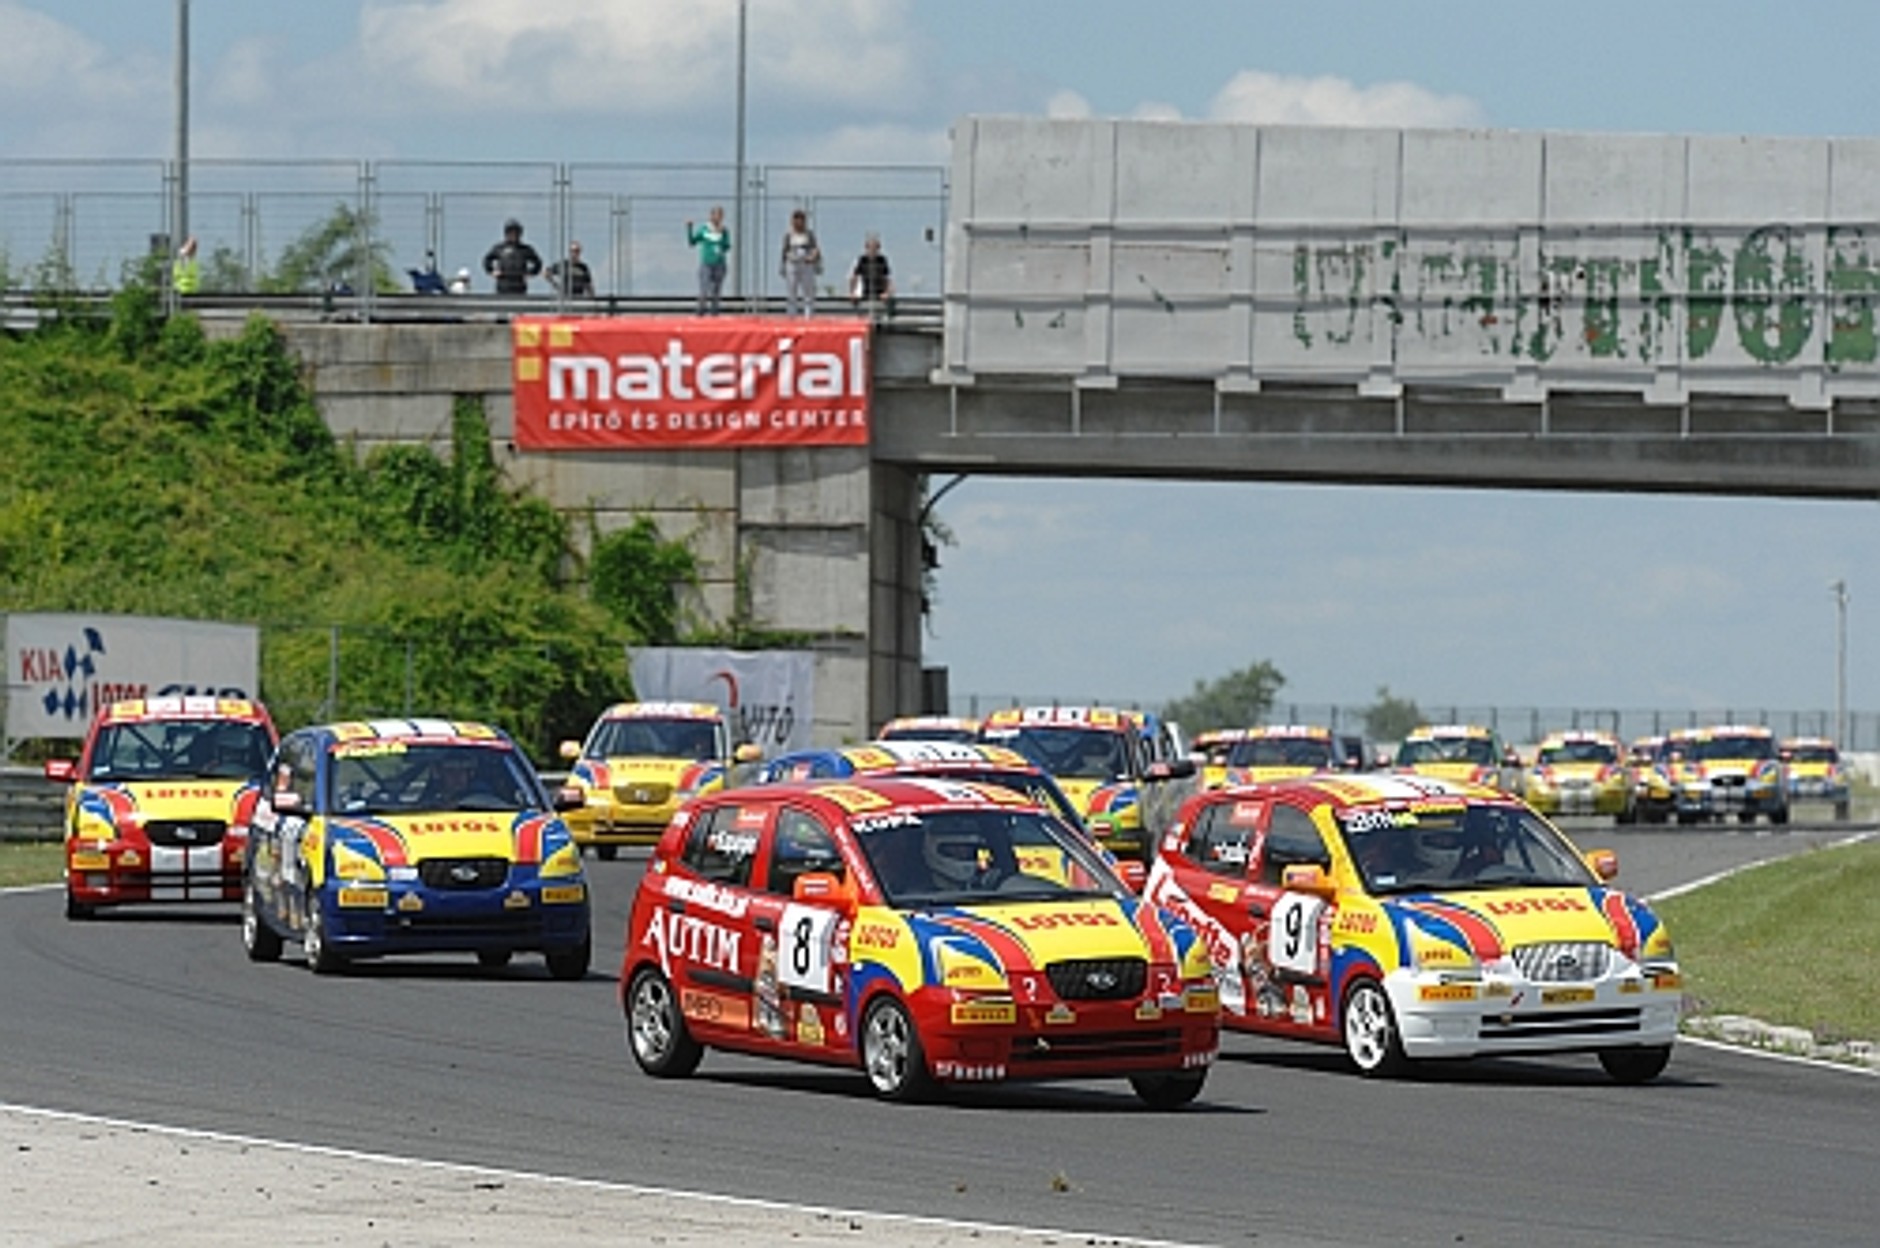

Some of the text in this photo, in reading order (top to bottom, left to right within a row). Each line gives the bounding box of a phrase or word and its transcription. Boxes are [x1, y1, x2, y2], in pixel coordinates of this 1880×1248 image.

[548, 337, 864, 401] material
[631, 409, 658, 430] ÉS
[669, 411, 761, 430] DESIGN
[770, 409, 866, 428] CENTER
[20, 649, 64, 682] KIA
[408, 819, 502, 836] LOTOS
[642, 905, 742, 978] AUTIM
[1011, 913, 1119, 931] LOTOS
[1285, 902, 1303, 959] 9
[793, 917, 814, 976] 8
